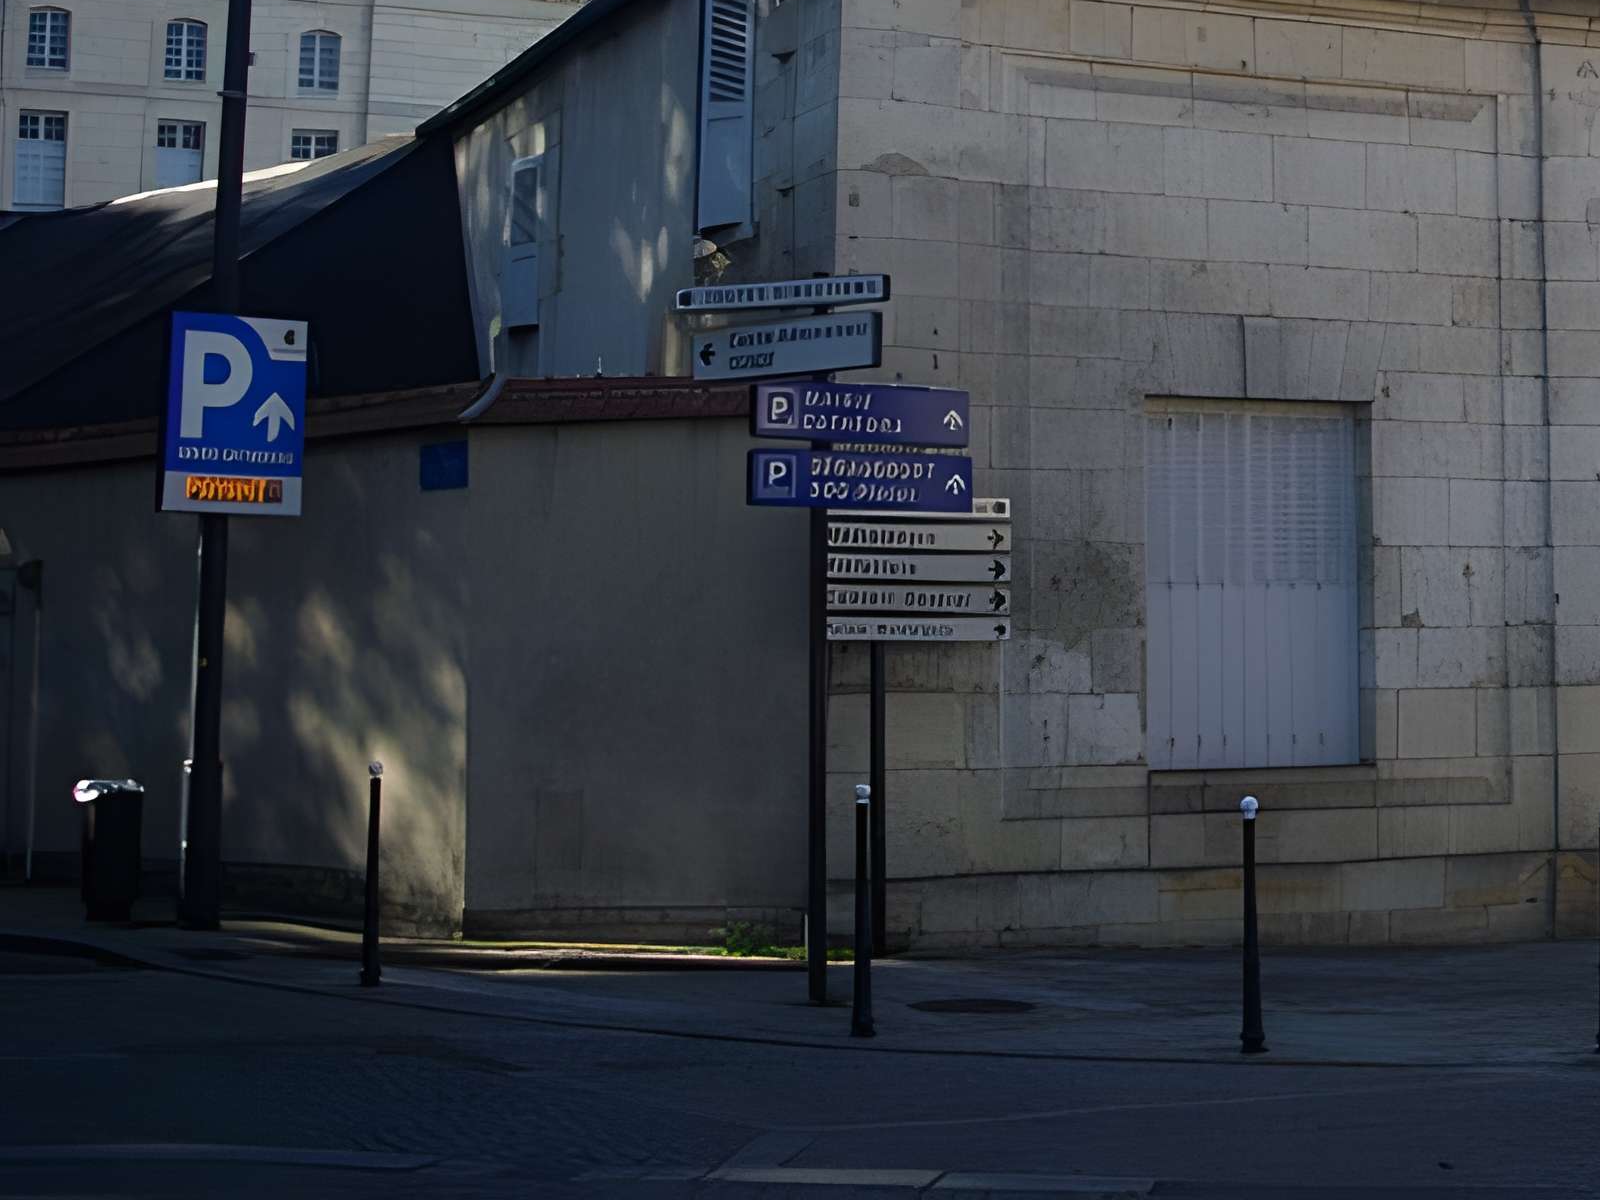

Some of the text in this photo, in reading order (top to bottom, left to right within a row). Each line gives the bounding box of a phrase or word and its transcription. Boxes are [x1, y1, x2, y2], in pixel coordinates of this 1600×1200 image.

[180, 329, 253, 438] P
[771, 396, 788, 420] P
[768, 461, 786, 485] P
